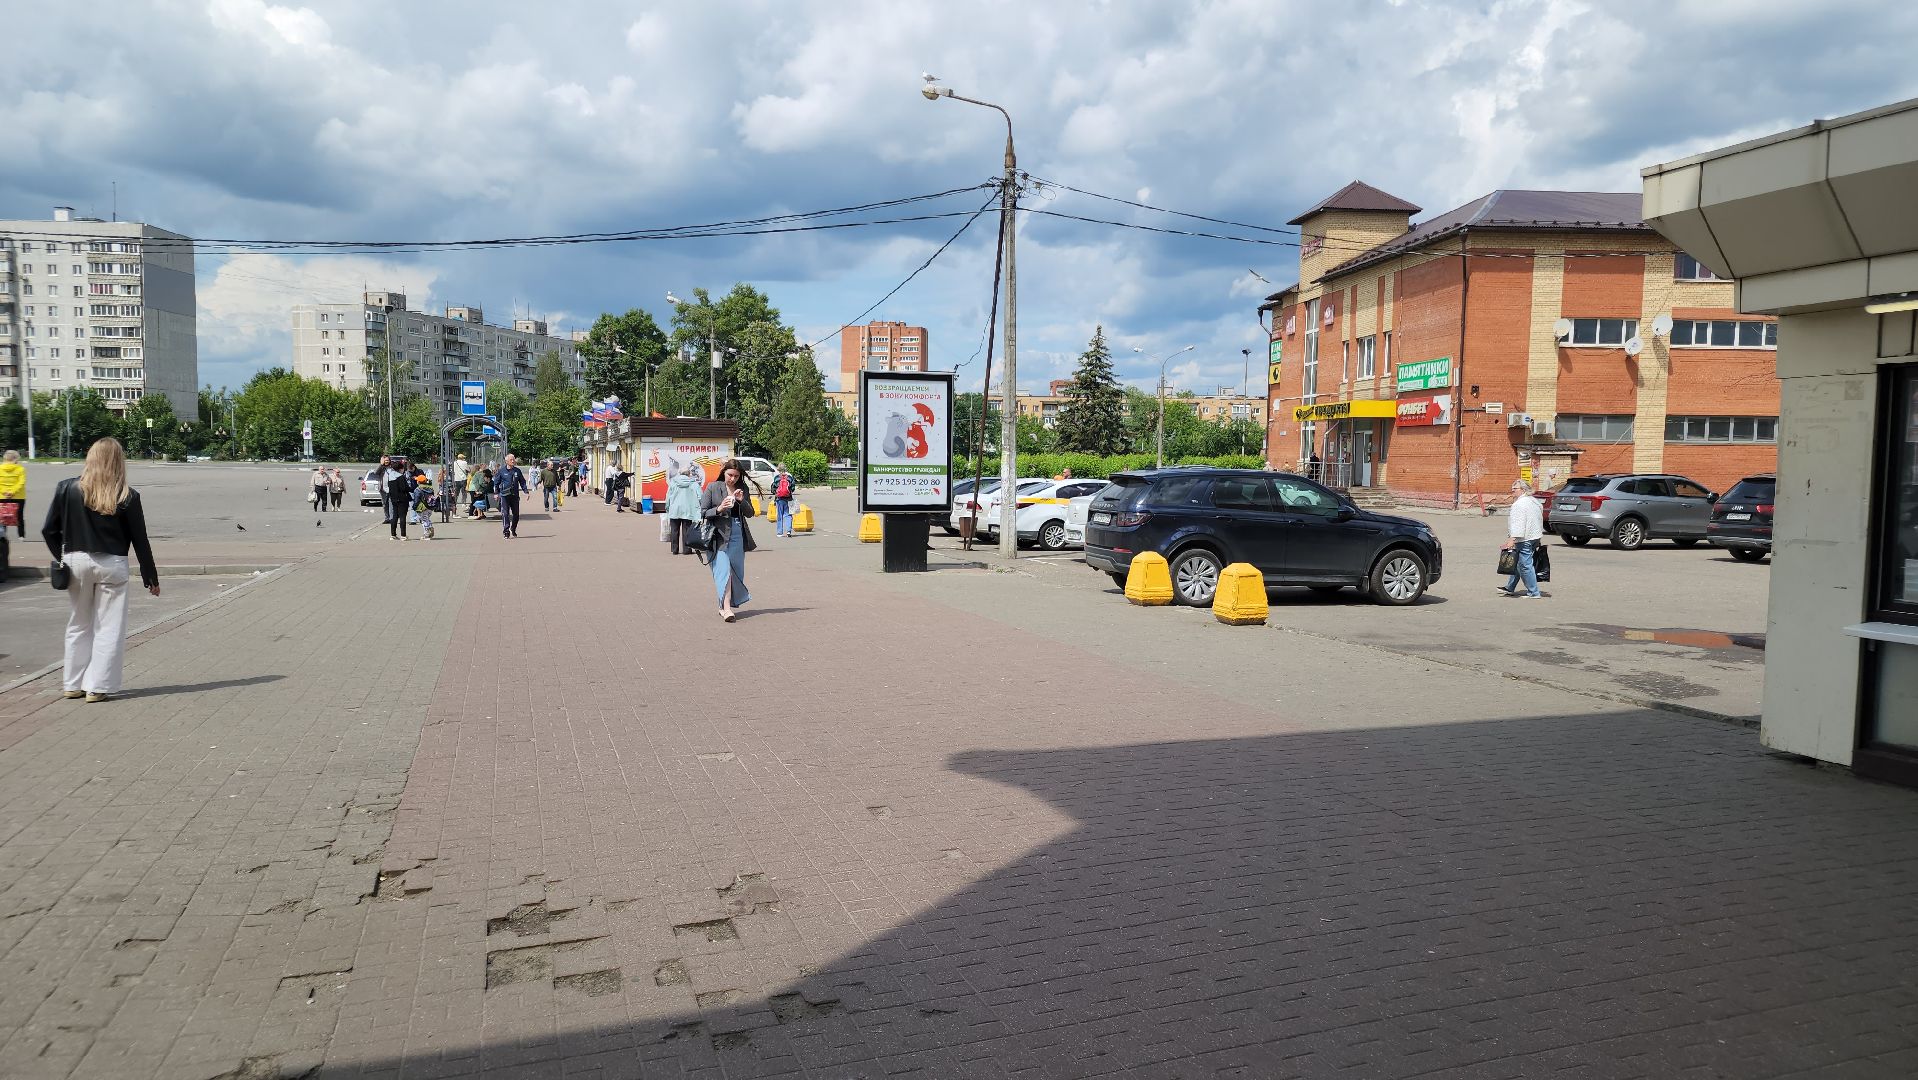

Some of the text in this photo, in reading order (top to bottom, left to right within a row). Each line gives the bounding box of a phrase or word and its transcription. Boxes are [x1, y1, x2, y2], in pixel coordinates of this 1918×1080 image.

[1399, 360, 1449, 380] ПАМЯТНИКИ
[676, 445, 719, 454] ГОРДИМСЯ!
[873, 478, 941, 486] +7 925 195 20 80
